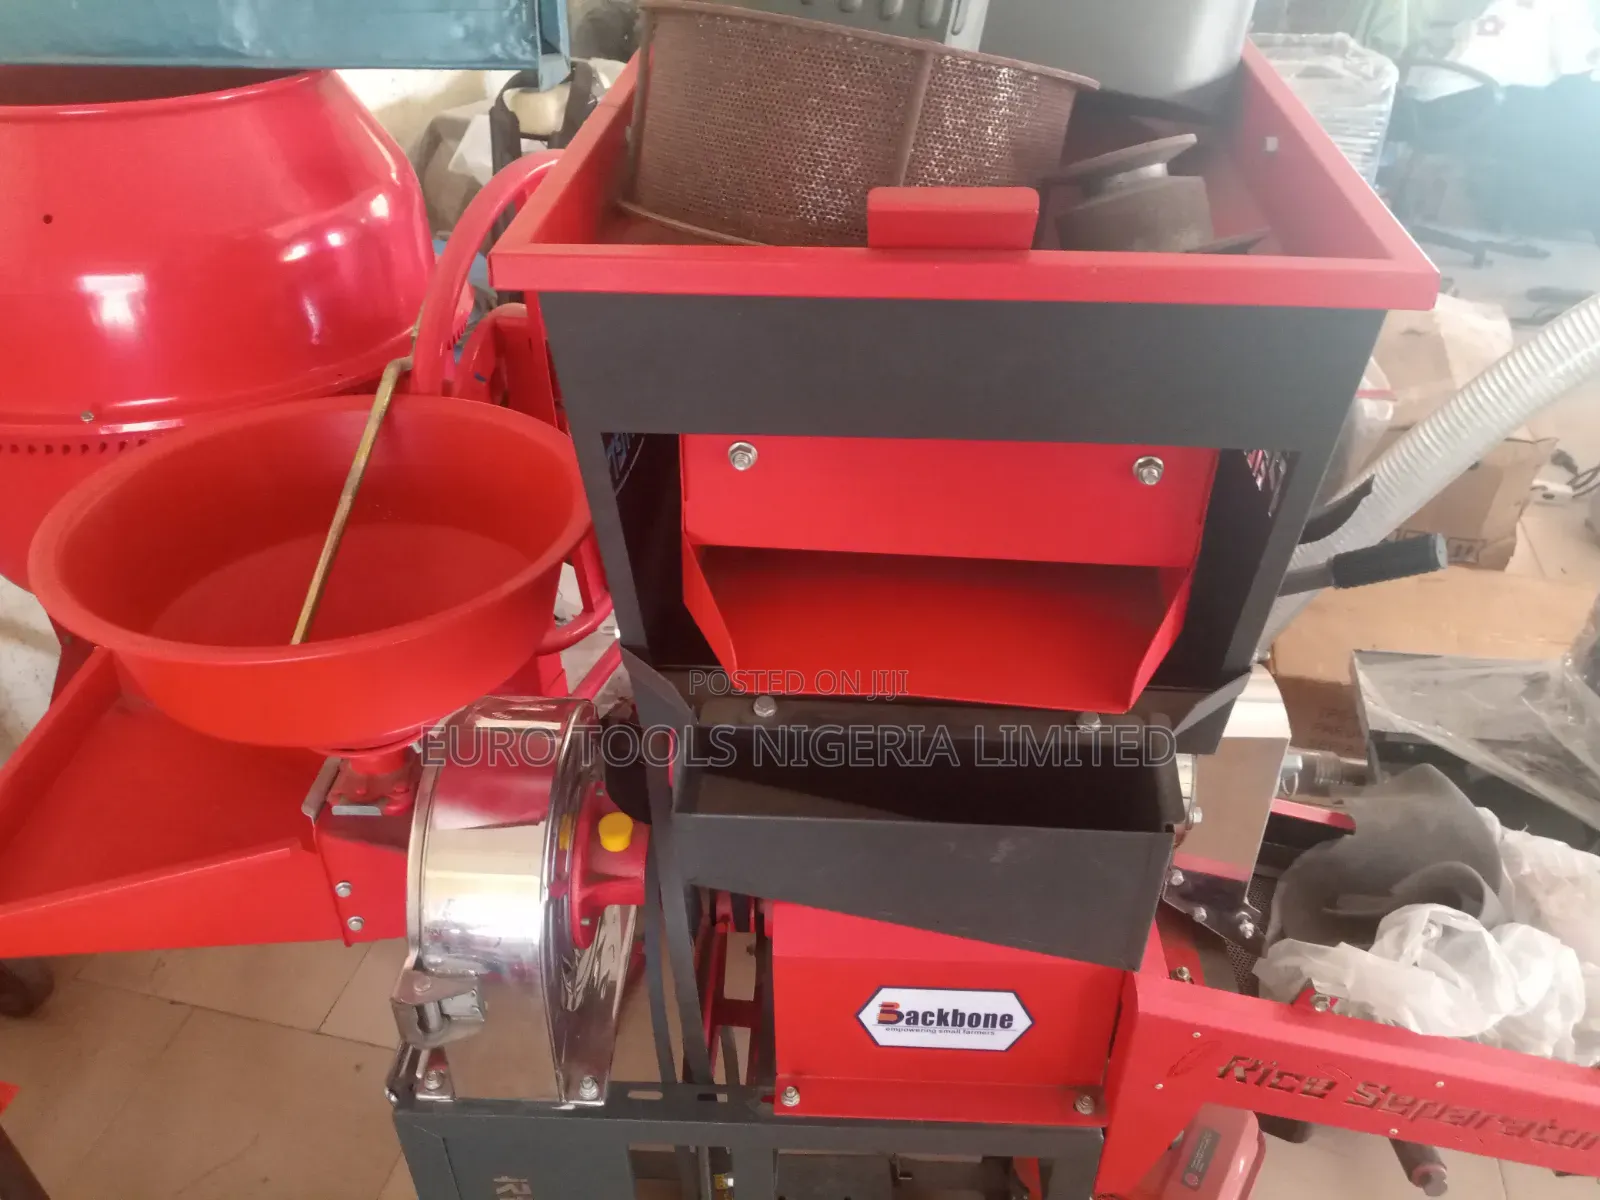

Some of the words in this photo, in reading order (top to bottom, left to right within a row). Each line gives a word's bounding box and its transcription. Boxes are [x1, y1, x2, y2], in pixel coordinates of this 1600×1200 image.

[877, 1001, 1014, 1029] Backbone
[885, 1026, 937, 1035] empowering
[1216, 1055, 1338, 1099] Rice
